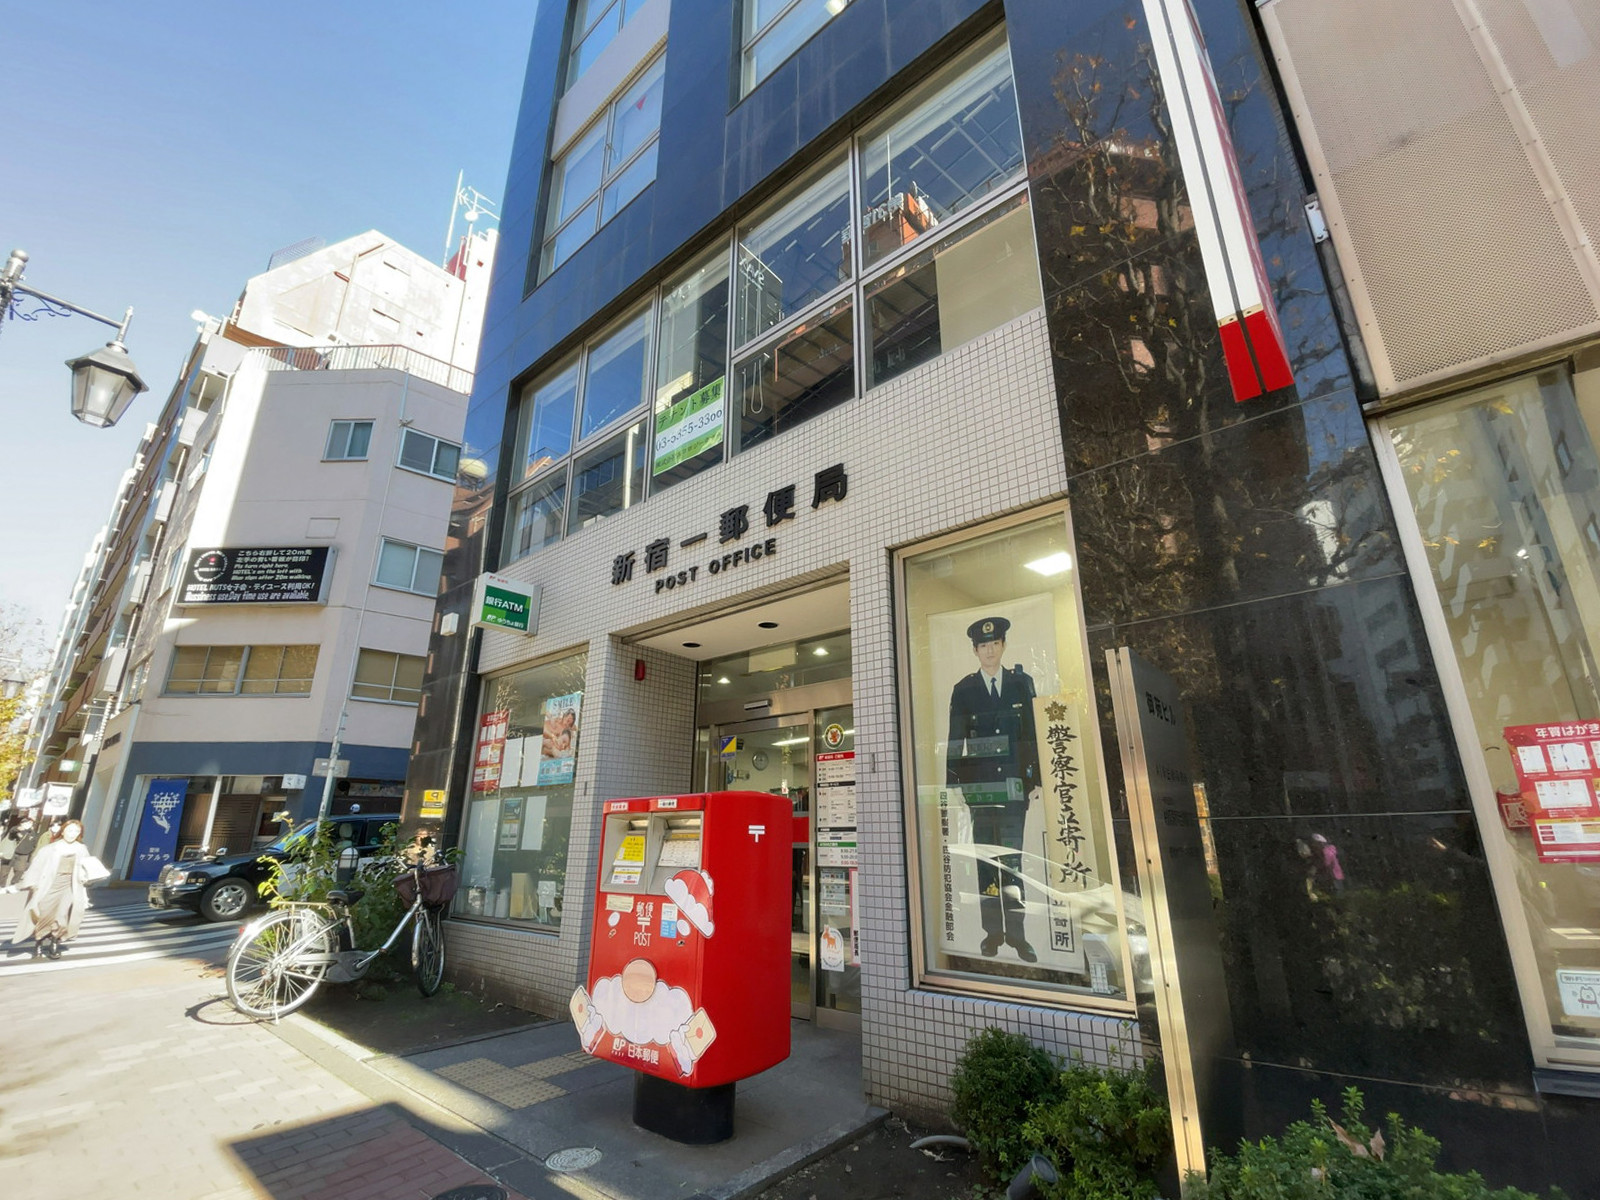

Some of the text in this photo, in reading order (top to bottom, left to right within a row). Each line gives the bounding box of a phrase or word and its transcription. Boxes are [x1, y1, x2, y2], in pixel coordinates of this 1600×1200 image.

[611, 462, 848, 586] 新宿一郵便局
[655, 537, 777, 594] POST OFFICE
[257, 592, 268, 600] use
[269, 592, 281, 600] are
[485, 596, 524, 612] 銀行ATM
[553, 697, 574, 710] SMILE
[1535, 723, 1600, 738] 年賀はがき
[1046, 724, 1093, 890] 警察官立寄り所
[636, 901, 654, 918] 郵便
[634, 932, 652, 947] POST
[628, 1044, 659, 1065] 日本郵便
